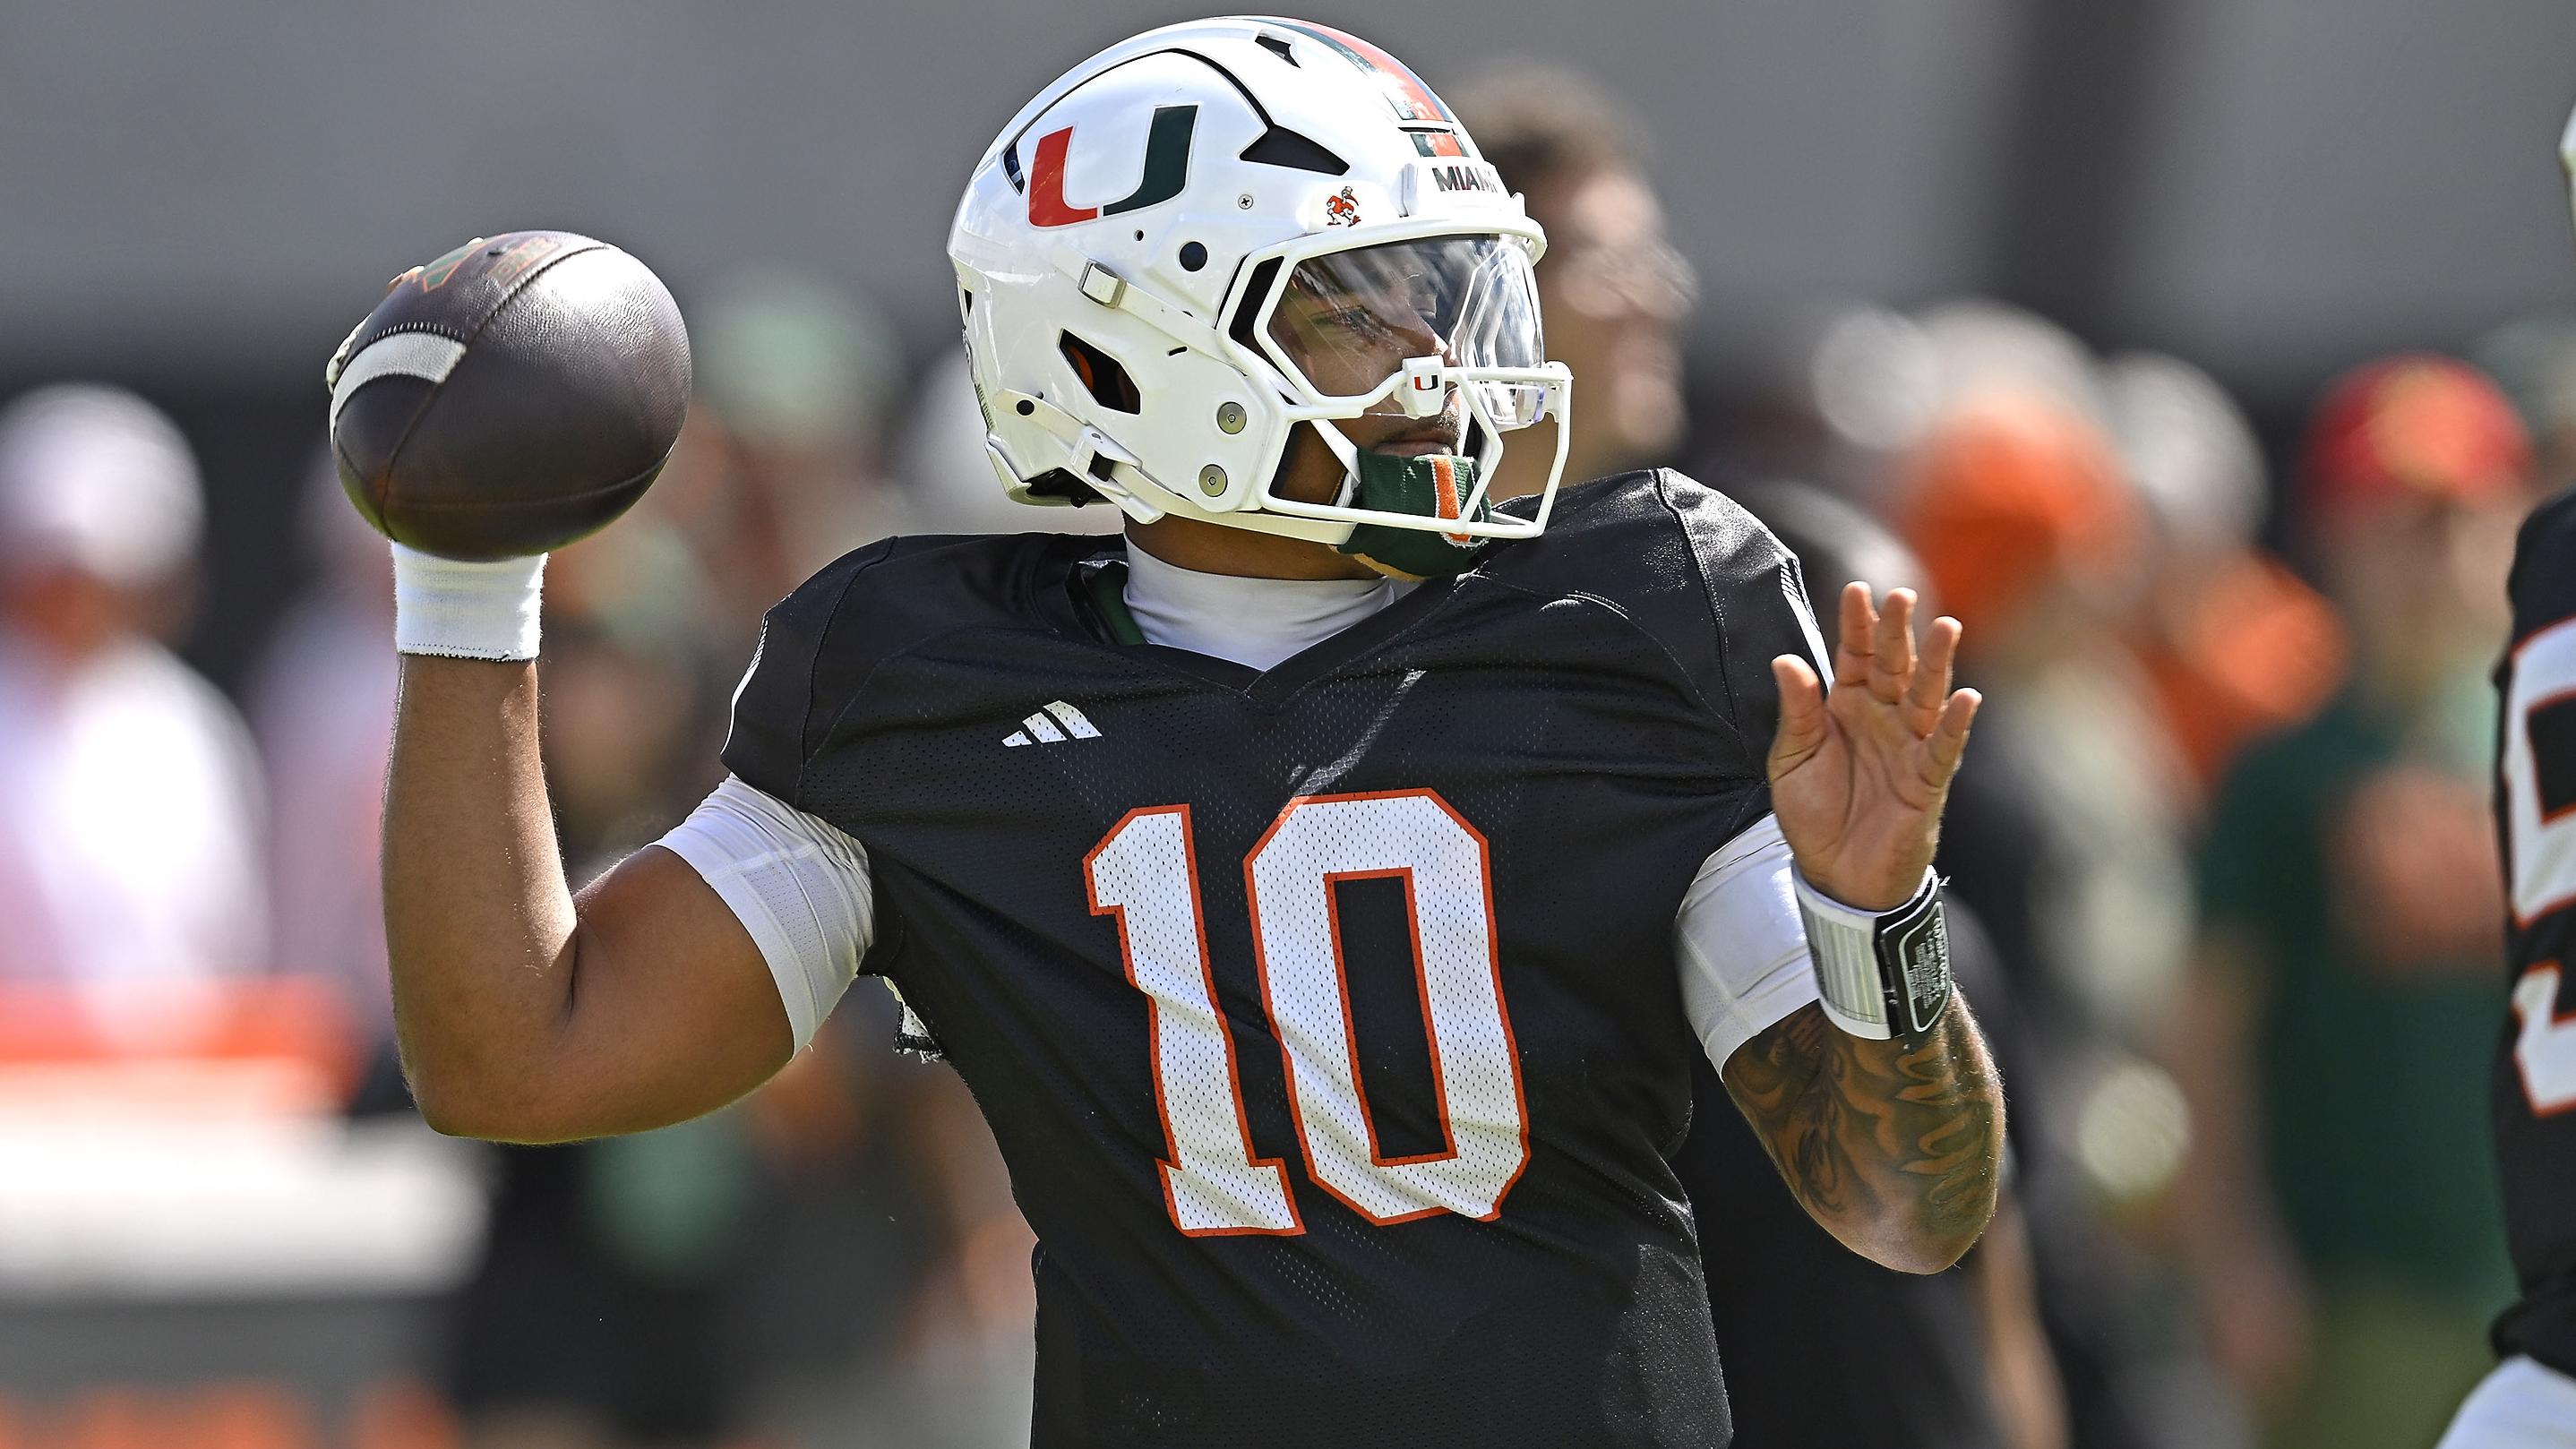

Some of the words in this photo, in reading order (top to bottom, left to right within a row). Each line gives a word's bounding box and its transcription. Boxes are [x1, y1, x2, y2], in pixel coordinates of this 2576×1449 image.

[1028, 105, 1198, 227] U
[1414, 375, 1438, 390] U
[1082, 788, 1532, 1237] 10
